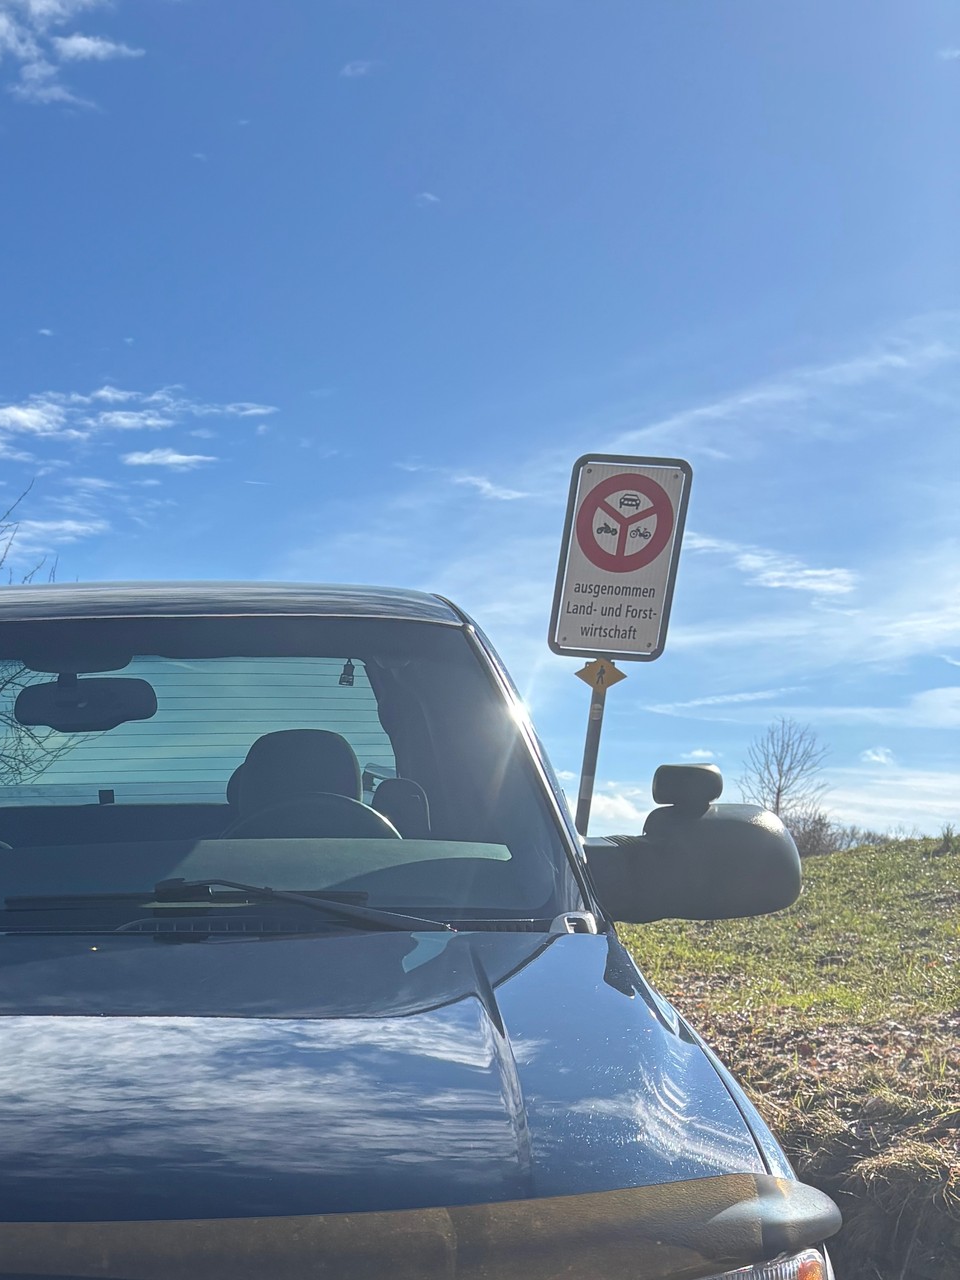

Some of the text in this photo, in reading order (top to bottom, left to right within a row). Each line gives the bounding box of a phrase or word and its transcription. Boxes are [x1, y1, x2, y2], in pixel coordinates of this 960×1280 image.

[574, 582, 656, 598] ausgenommen
[566, 601, 657, 620] Land- und Forst-
[580, 623, 637, 640] wirtschaft
